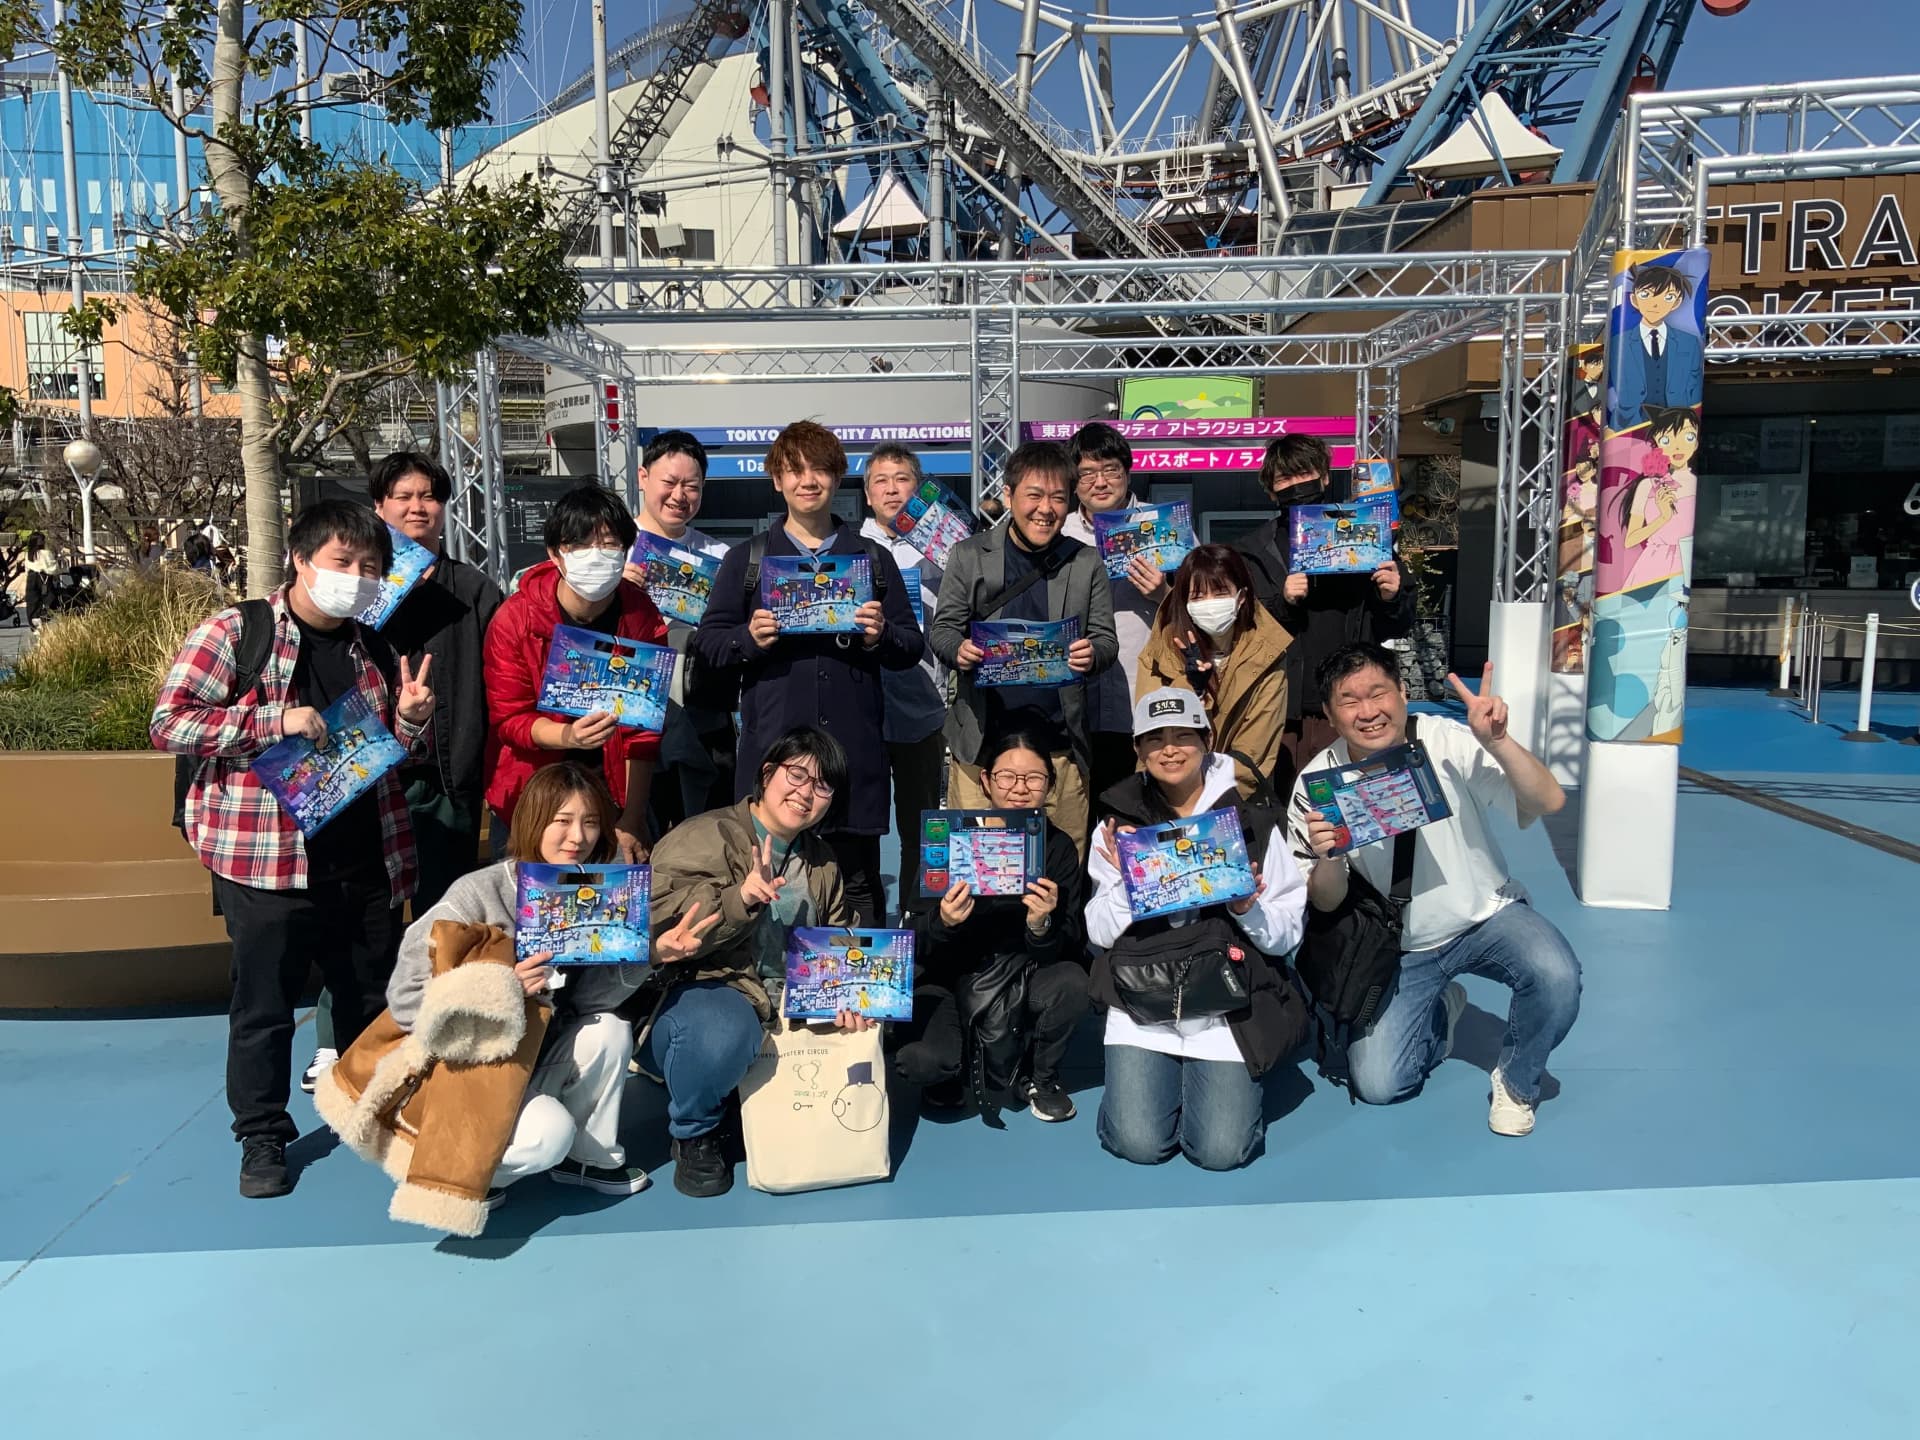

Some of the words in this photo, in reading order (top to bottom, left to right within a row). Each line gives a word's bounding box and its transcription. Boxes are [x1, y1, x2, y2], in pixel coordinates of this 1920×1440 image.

[1706, 194, 1919, 274] TRA
[1033, 244, 1070, 255] docoo
[726, 429, 780, 442] TOKYO
[832, 428, 866, 440] CITY
[870, 426, 972, 440] ATTRACTIONS
[1167, 420, 1287, 436] アトラクションズ
